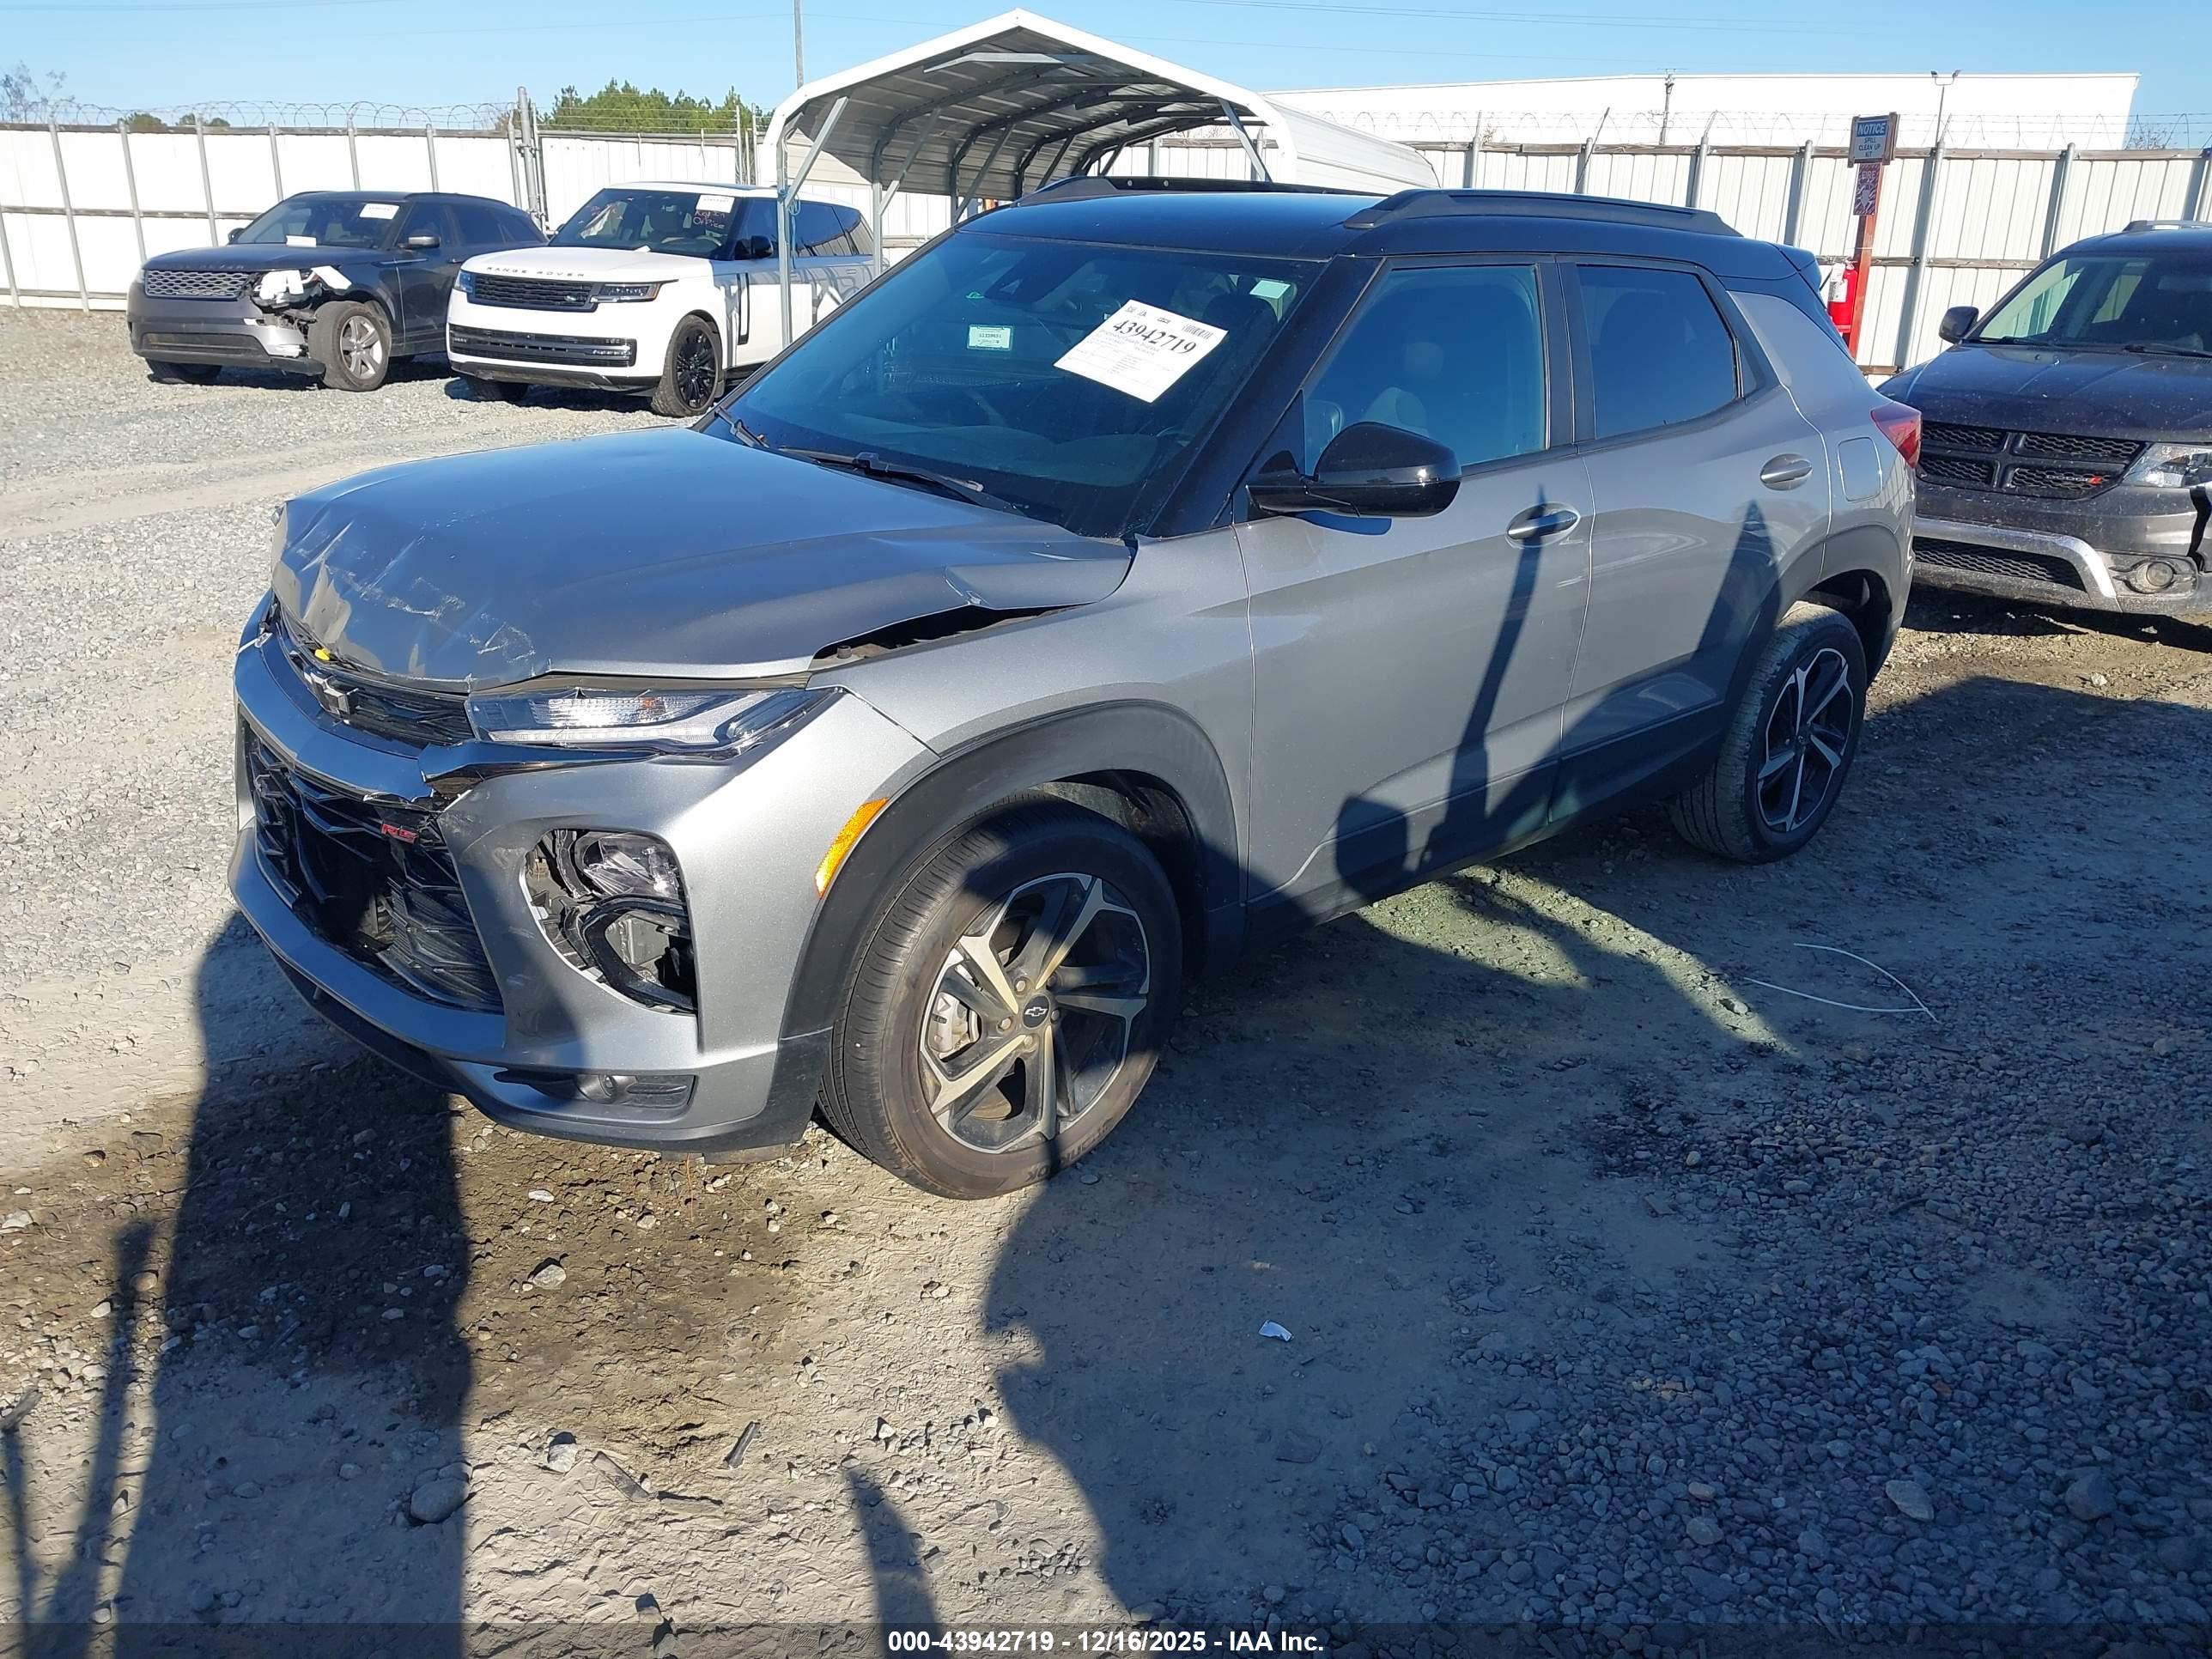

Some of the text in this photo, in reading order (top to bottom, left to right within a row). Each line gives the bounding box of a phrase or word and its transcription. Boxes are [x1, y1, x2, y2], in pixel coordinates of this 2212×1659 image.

[1857, 122, 1887, 136] NOTICE
[1113, 319, 1197, 354] 43942719
[380, 823, 418, 844] RS
